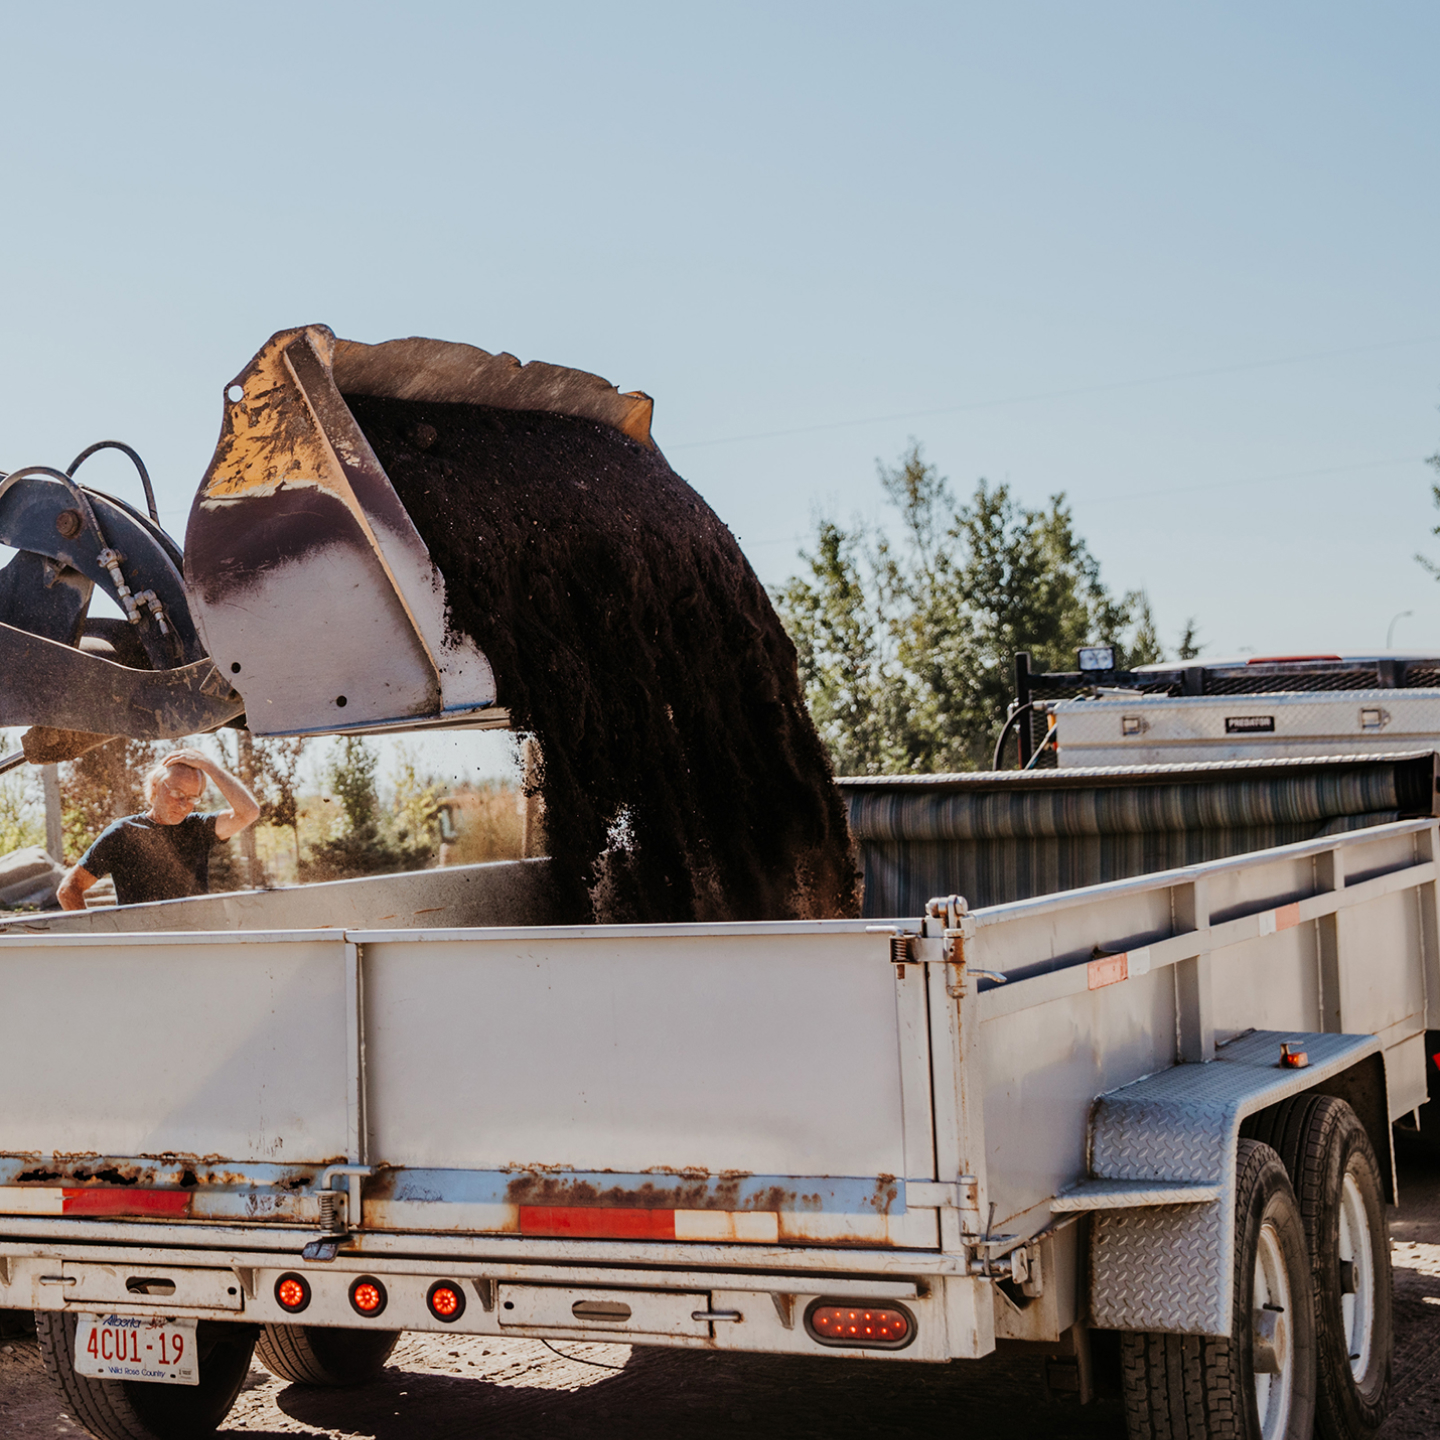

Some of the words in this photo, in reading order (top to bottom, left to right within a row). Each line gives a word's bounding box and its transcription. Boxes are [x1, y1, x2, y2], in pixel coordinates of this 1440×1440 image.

[103, 1314, 142, 1329] Alberta
[87, 1328, 184, 1365] 4CU1-19
[108, 1366, 123, 1375] Wild
[124, 1367, 140, 1375] Rose
[141, 1368, 166, 1378] Country
